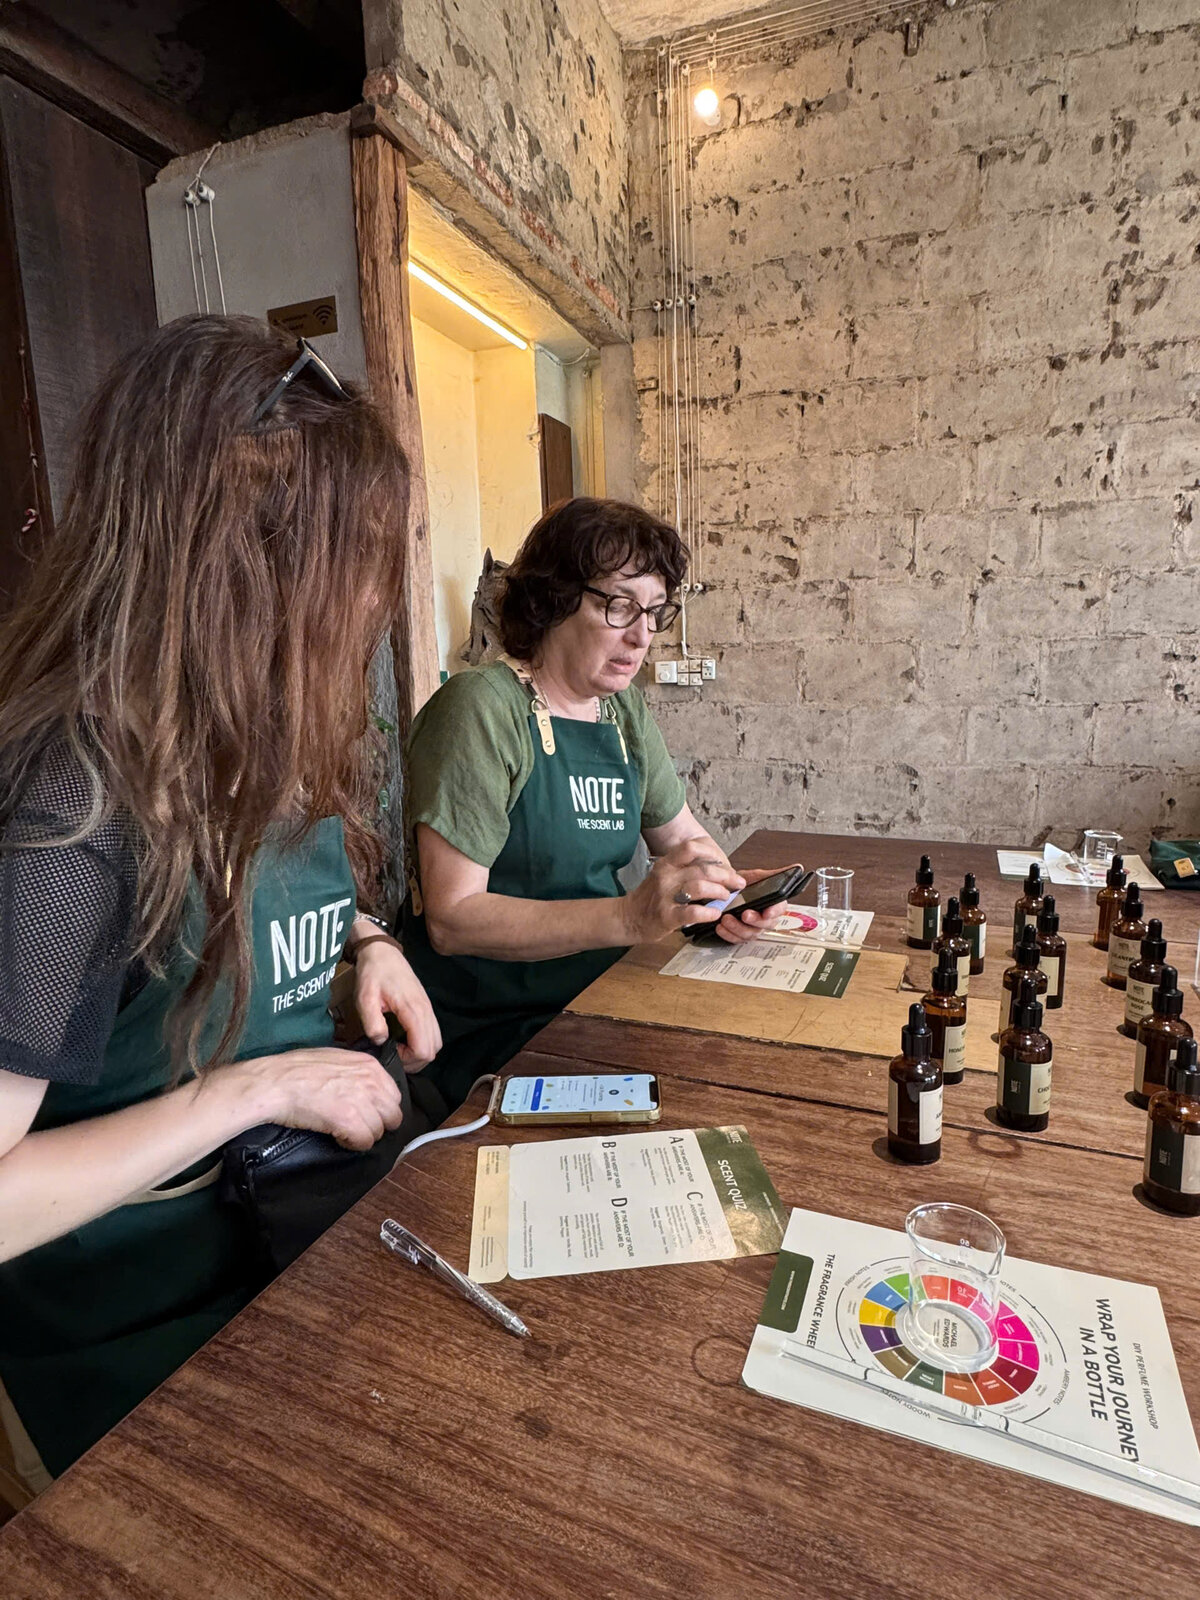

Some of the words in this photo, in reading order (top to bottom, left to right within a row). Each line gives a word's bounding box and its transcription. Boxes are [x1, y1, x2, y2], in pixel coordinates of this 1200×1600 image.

[569, 775, 625, 814] NOTE
[577, 818, 591, 830] THE
[591, 819, 611, 830] SCENT
[612, 820, 625, 830] LAB
[270, 898, 351, 985] NOTE
[272, 989, 296, 1013] THE
[297, 971, 326, 1002] SCENT
[669, 1136, 684, 1144] A
[611, 1198, 627, 1207] D
[686, 1191, 703, 1201] C
[718, 1160, 737, 1187] SCENT
[728, 1188, 747, 1210] QUIZ
[825, 1253, 835, 1269] THE
[813, 1269, 832, 1318] FRAGRANCE
[1080, 1327, 1095, 1343] IN
[1096, 1299, 1116, 1341] WRAP
[1082, 1344, 1097, 1356] A
[1104, 1345, 1124, 1387] YOUR
[1084, 1360, 1108, 1421] BOTTLE
[1135, 1355, 1149, 1386] PERFUME
[1143, 1387, 1158, 1429] WORKSHOP
[903, 1403, 931, 1418] WOODY
